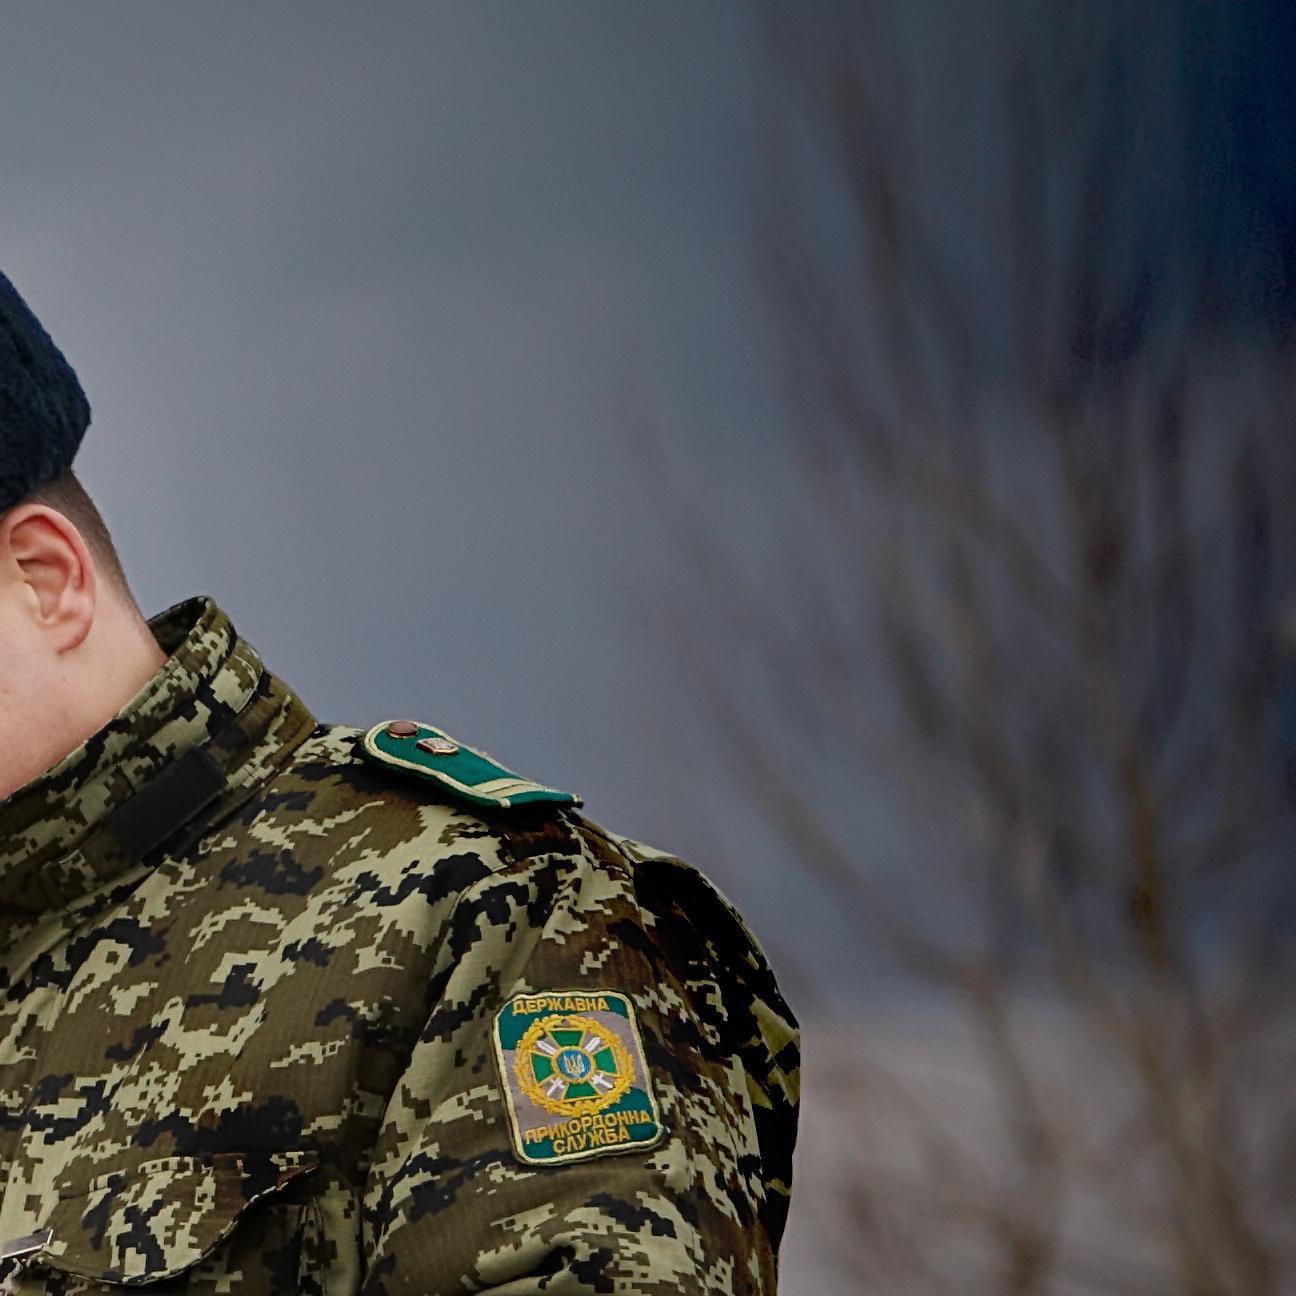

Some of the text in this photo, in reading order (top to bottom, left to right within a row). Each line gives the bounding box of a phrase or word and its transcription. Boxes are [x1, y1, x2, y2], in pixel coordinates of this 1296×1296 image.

[512, 997, 610, 1015] ДЕРЖАВНА
[523, 1110, 651, 1144] ПРИКОРДОННА
[553, 1126, 631, 1153] СЛУЖБА
